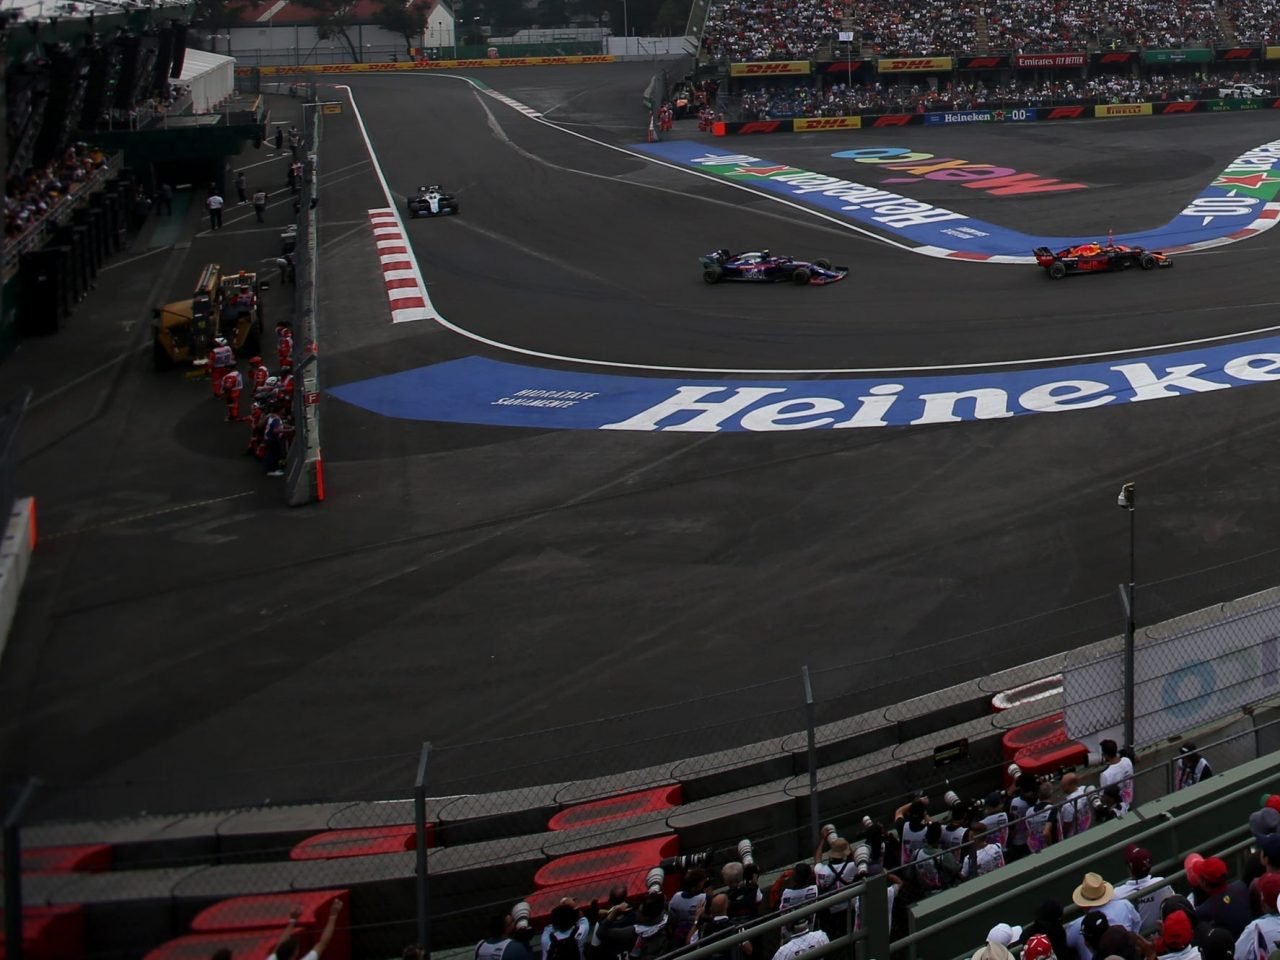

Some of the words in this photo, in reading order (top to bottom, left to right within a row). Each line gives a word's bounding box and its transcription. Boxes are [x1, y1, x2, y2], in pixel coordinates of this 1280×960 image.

[891, 60, 934, 70] DHL
[1019, 57, 1054, 67] Emirates
[1055, 56, 1065, 65] FLY
[1065, 56, 1083, 65] BETTER
[745, 63, 792, 73] DHL
[1106, 105, 1141, 115] PIRELLI
[945, 113, 990, 122] Heineken
[806, 119, 850, 128] DHL
[769, 172, 969, 228] Heineken
